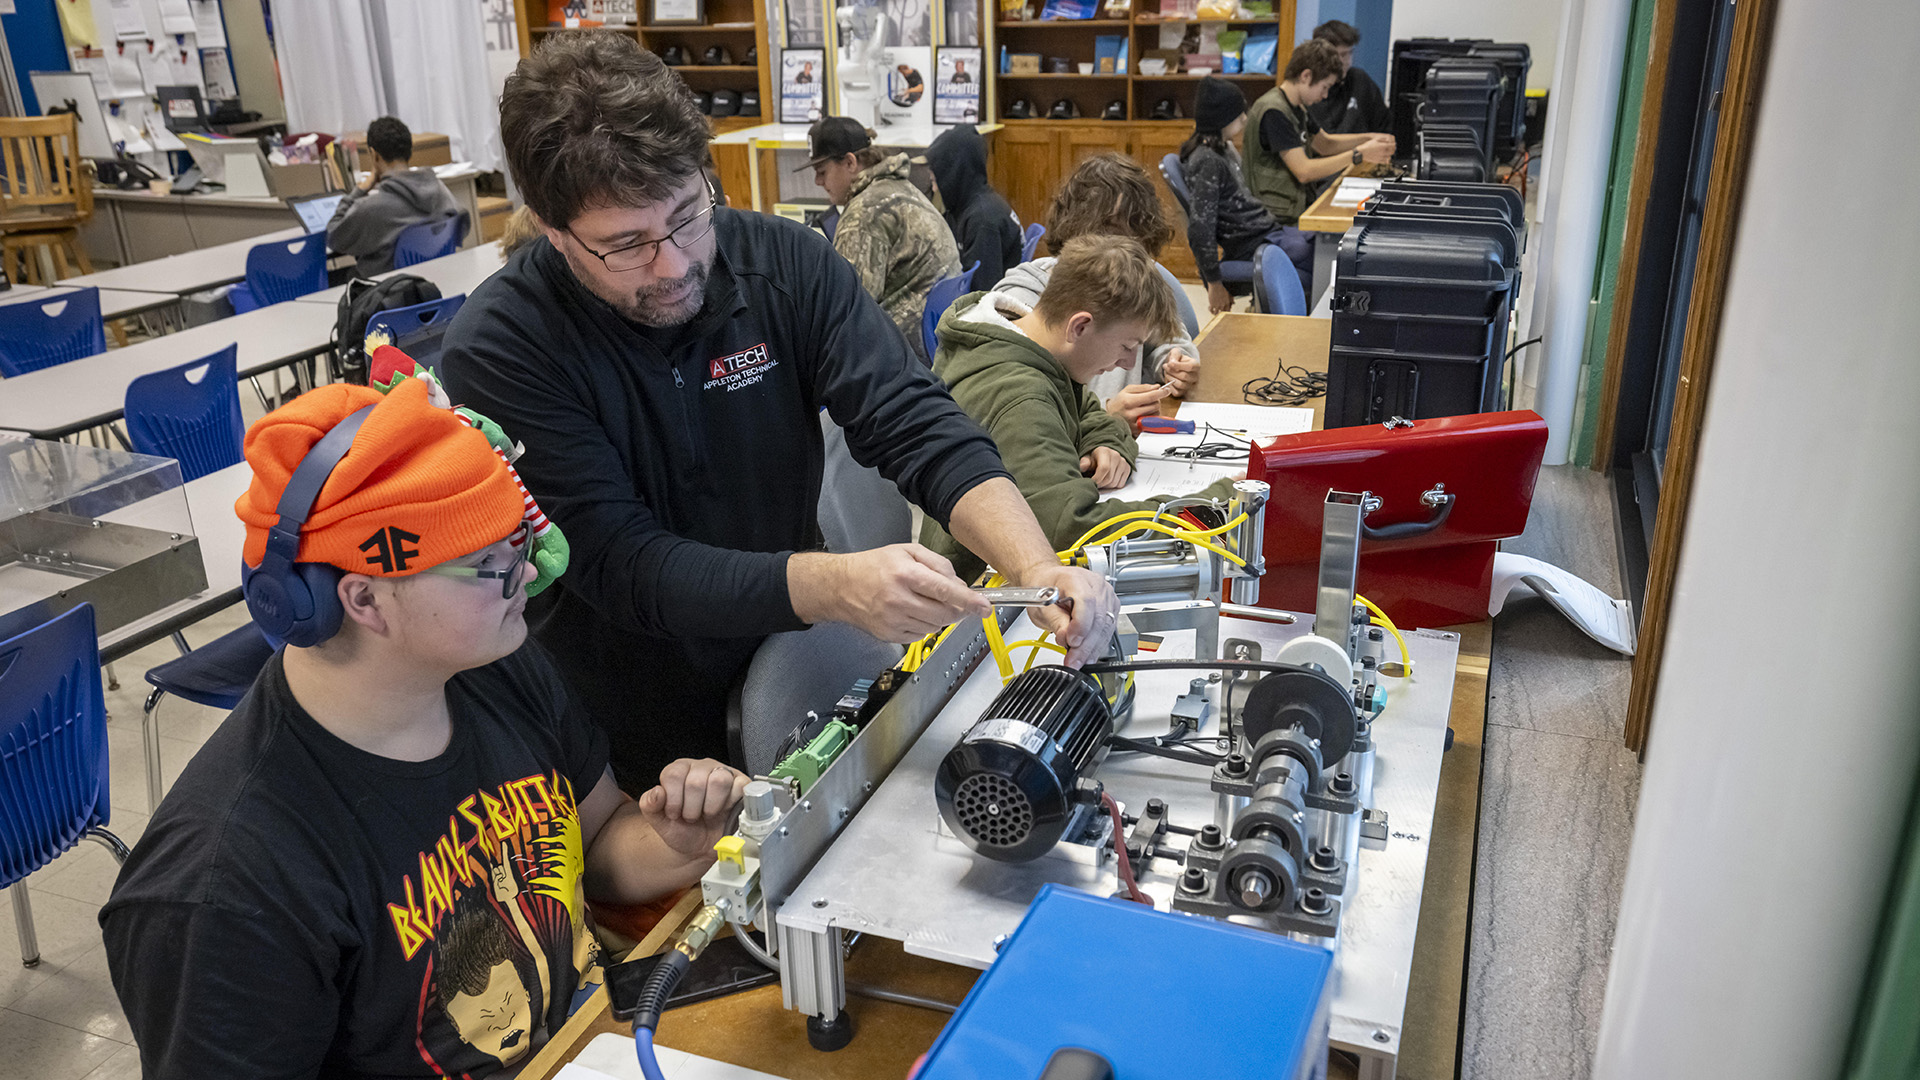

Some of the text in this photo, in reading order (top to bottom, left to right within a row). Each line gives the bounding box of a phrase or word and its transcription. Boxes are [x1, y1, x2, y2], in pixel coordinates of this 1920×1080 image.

[703, 359, 780, 391] APPLETON TECHNICAL
[726, 374, 764, 393] ACADEMY
